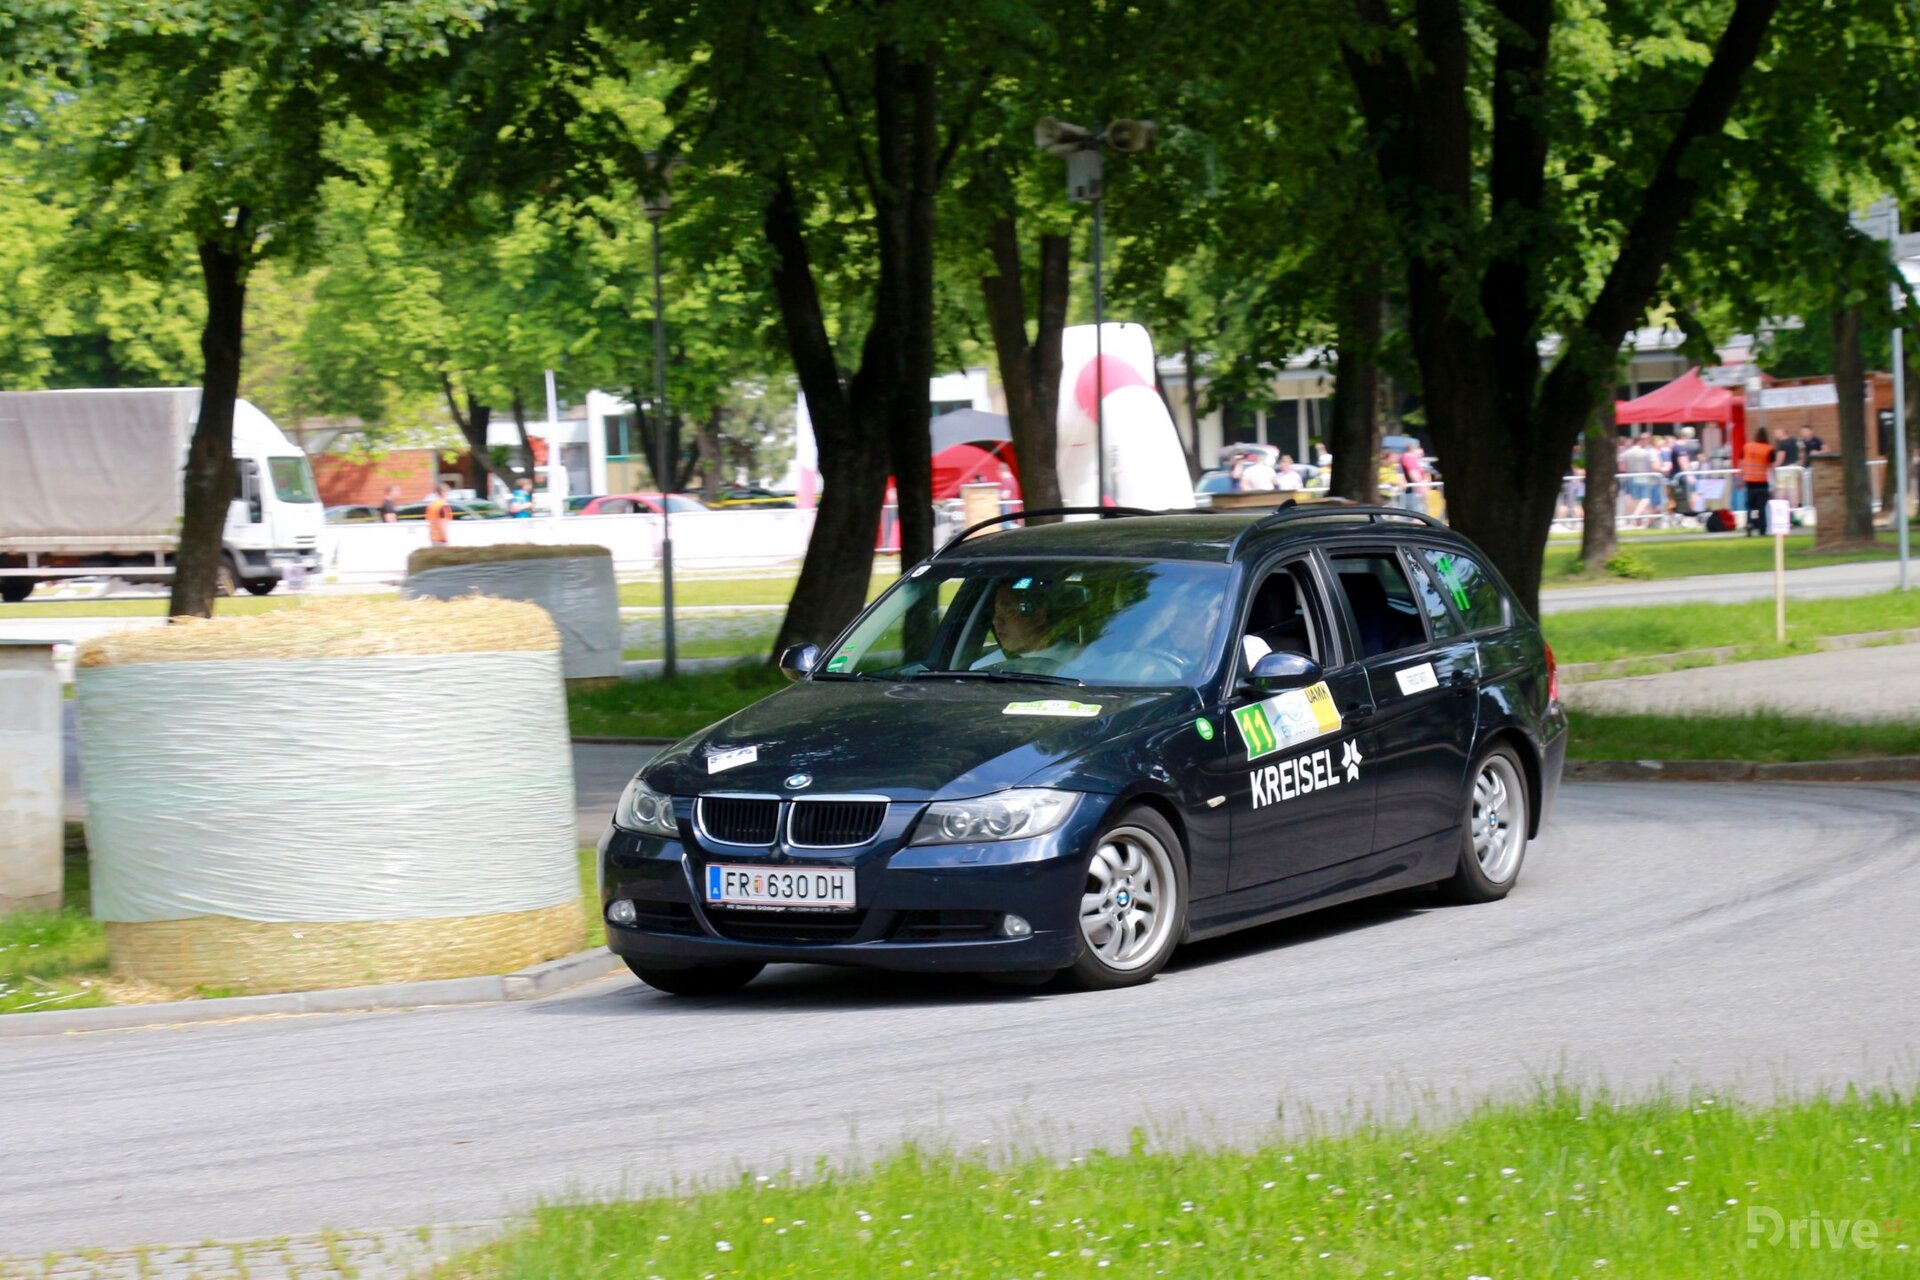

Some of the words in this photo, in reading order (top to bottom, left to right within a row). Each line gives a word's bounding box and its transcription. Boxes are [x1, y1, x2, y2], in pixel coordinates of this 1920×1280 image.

[1242, 709, 1273, 753] 11
[1249, 748, 1341, 810] KREISEL
[726, 871, 750, 897] FR
[767, 874, 808, 898] 630
[816, 875, 844, 900] DH
